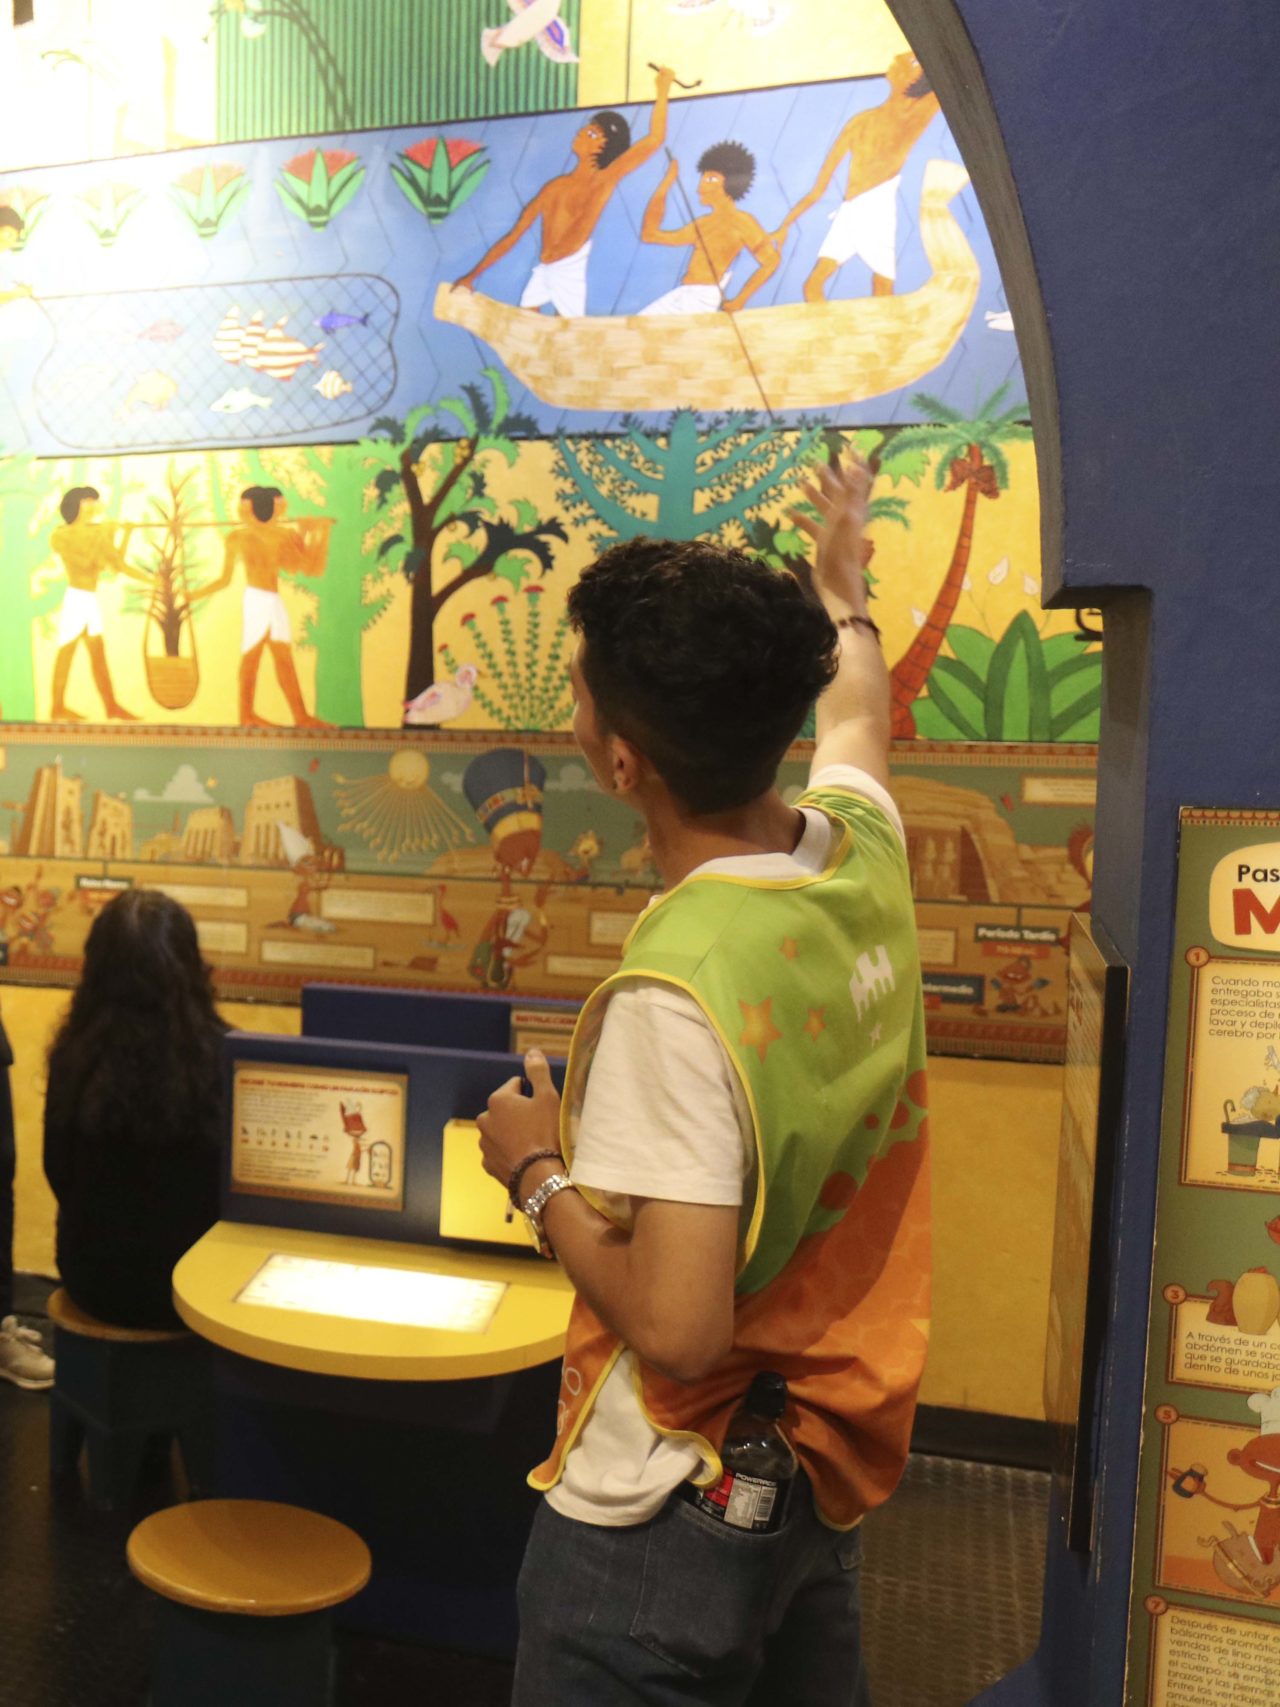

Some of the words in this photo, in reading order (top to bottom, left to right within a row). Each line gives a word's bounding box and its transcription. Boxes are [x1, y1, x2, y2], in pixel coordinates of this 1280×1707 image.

[1238, 864, 1280, 883] Pas
[1211, 976, 1259, 987] Cuando
[1211, 987, 1273, 999] entregaba
[1209, 1008, 1256, 1018] proceso
[1258, 1010, 1275, 1019] de
[1209, 1016, 1238, 1026] lavar
[1240, 1020, 1248, 1029] y
[1208, 1028, 1254, 1039] cerebro
[1256, 1032, 1277, 1041] por
[1186, 1331, 1195, 1340] A
[1198, 1332, 1231, 1344] través
[1233, 1338, 1250, 1347] de
[1252, 1341, 1267, 1349] un
[1185, 1342, 1242, 1355] abdómen
[1245, 1350, 1257, 1358] se
[1184, 1352, 1206, 1363] que
[1210, 1354, 1223, 1363] se
[1184, 1360, 1221, 1374] dentro
[1224, 1366, 1240, 1376] de
[1242, 1370, 1269, 1380] unos
[1171, 1615, 1218, 1632] Después
[1221, 1625, 1237, 1635] de
[1240, 1630, 1269, 1641] untar
[1170, 1627, 1223, 1643] bálsamos
[1227, 1638, 1280, 1654] aromátic
[1169, 1637, 1210, 1653] vendas
[1213, 1645, 1229, 1655] de
[1232, 1648, 1251, 1660] lino
[1168, 1659, 1178, 1667] el
[1166, 1678, 1194, 1692] Entre
[1206, 1678, 1214, 1687] y
